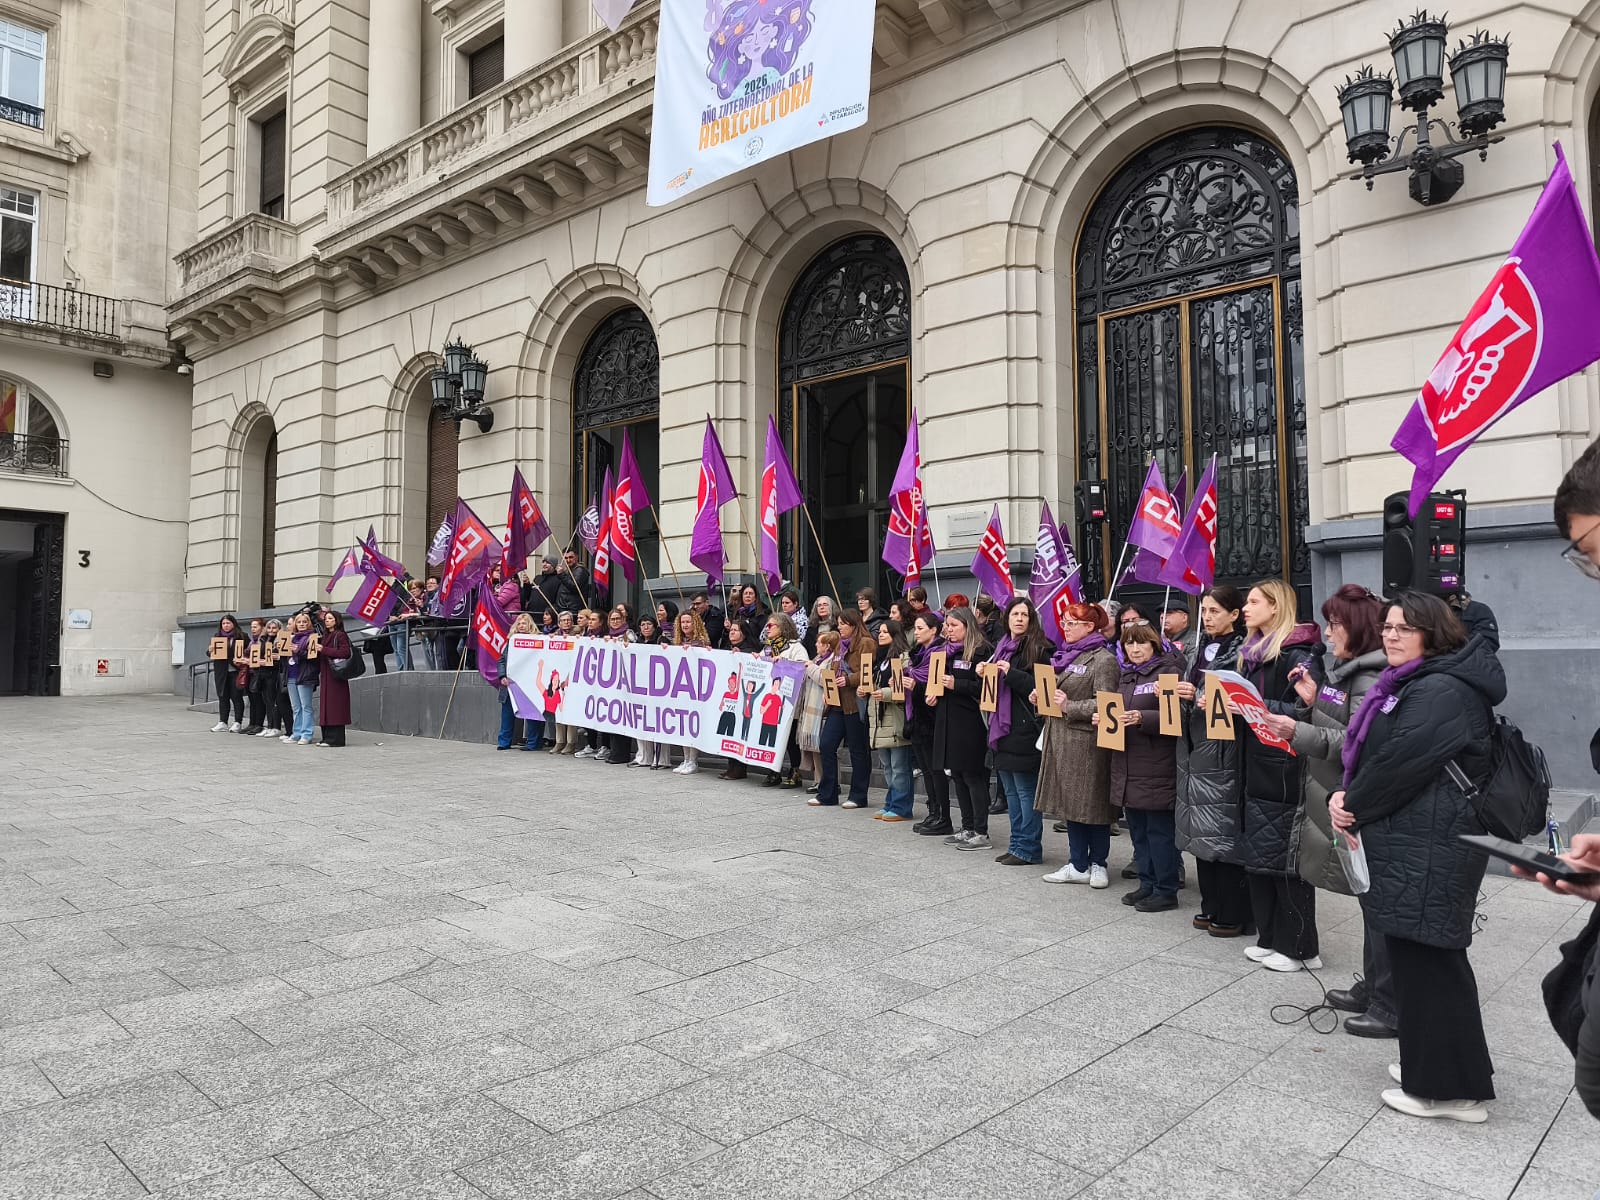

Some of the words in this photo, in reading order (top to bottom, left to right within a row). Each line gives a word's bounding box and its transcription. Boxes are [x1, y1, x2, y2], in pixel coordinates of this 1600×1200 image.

[701, 105, 717, 126] AÑO
[718, 77, 786, 119] INTERNACIONAL
[788, 68, 801, 88] DE
[802, 62, 814, 81] LA
[744, 74, 768, 95] 2026
[699, 75, 814, 151] AGRICULTORA
[78, 550, 91, 568] 3
[572, 645, 717, 702] IGUALDAD
[1322, 686, 1338, 697] UGT
[584, 694, 596, 720] O
[596, 697, 700, 739] CONFLICTO
[745, 748, 764, 760] UGT
